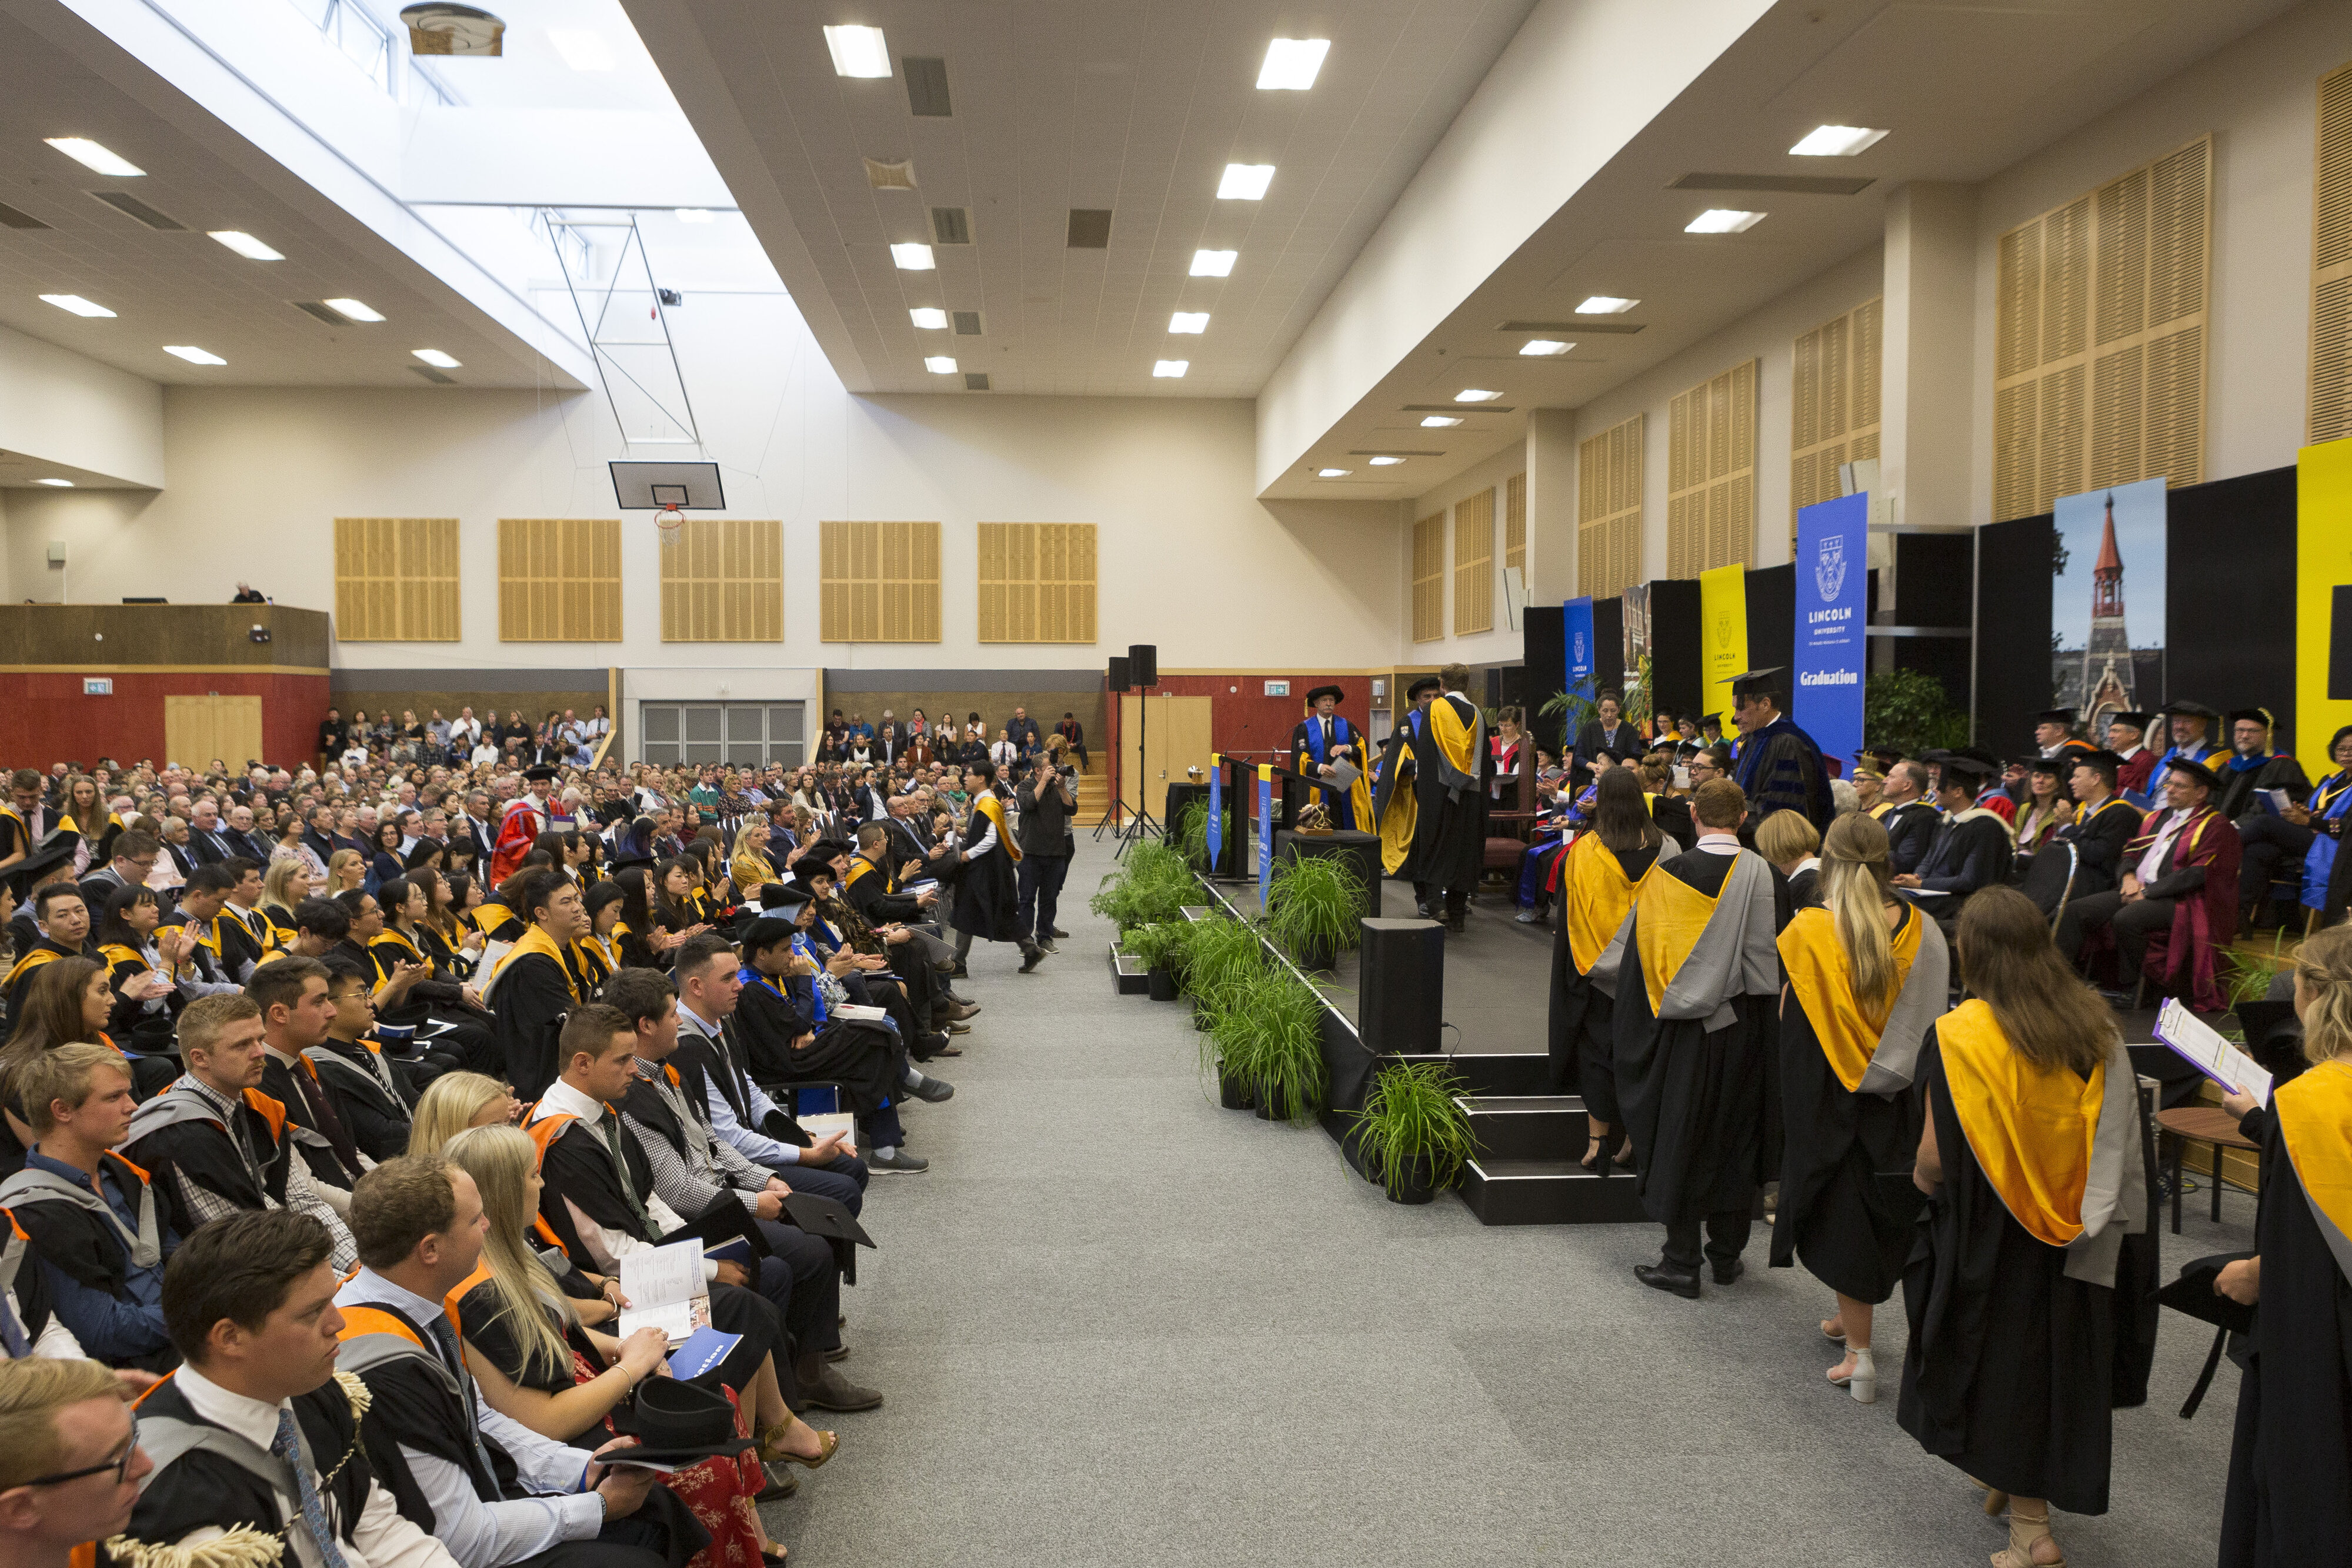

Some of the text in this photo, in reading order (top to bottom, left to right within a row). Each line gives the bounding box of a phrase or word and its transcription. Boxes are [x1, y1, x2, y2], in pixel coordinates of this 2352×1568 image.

[1809, 607, 1851, 623] LINCOLN
[1814, 626, 1846, 635] UNIVERSITY
[1800, 668, 1858, 686] Graduation
